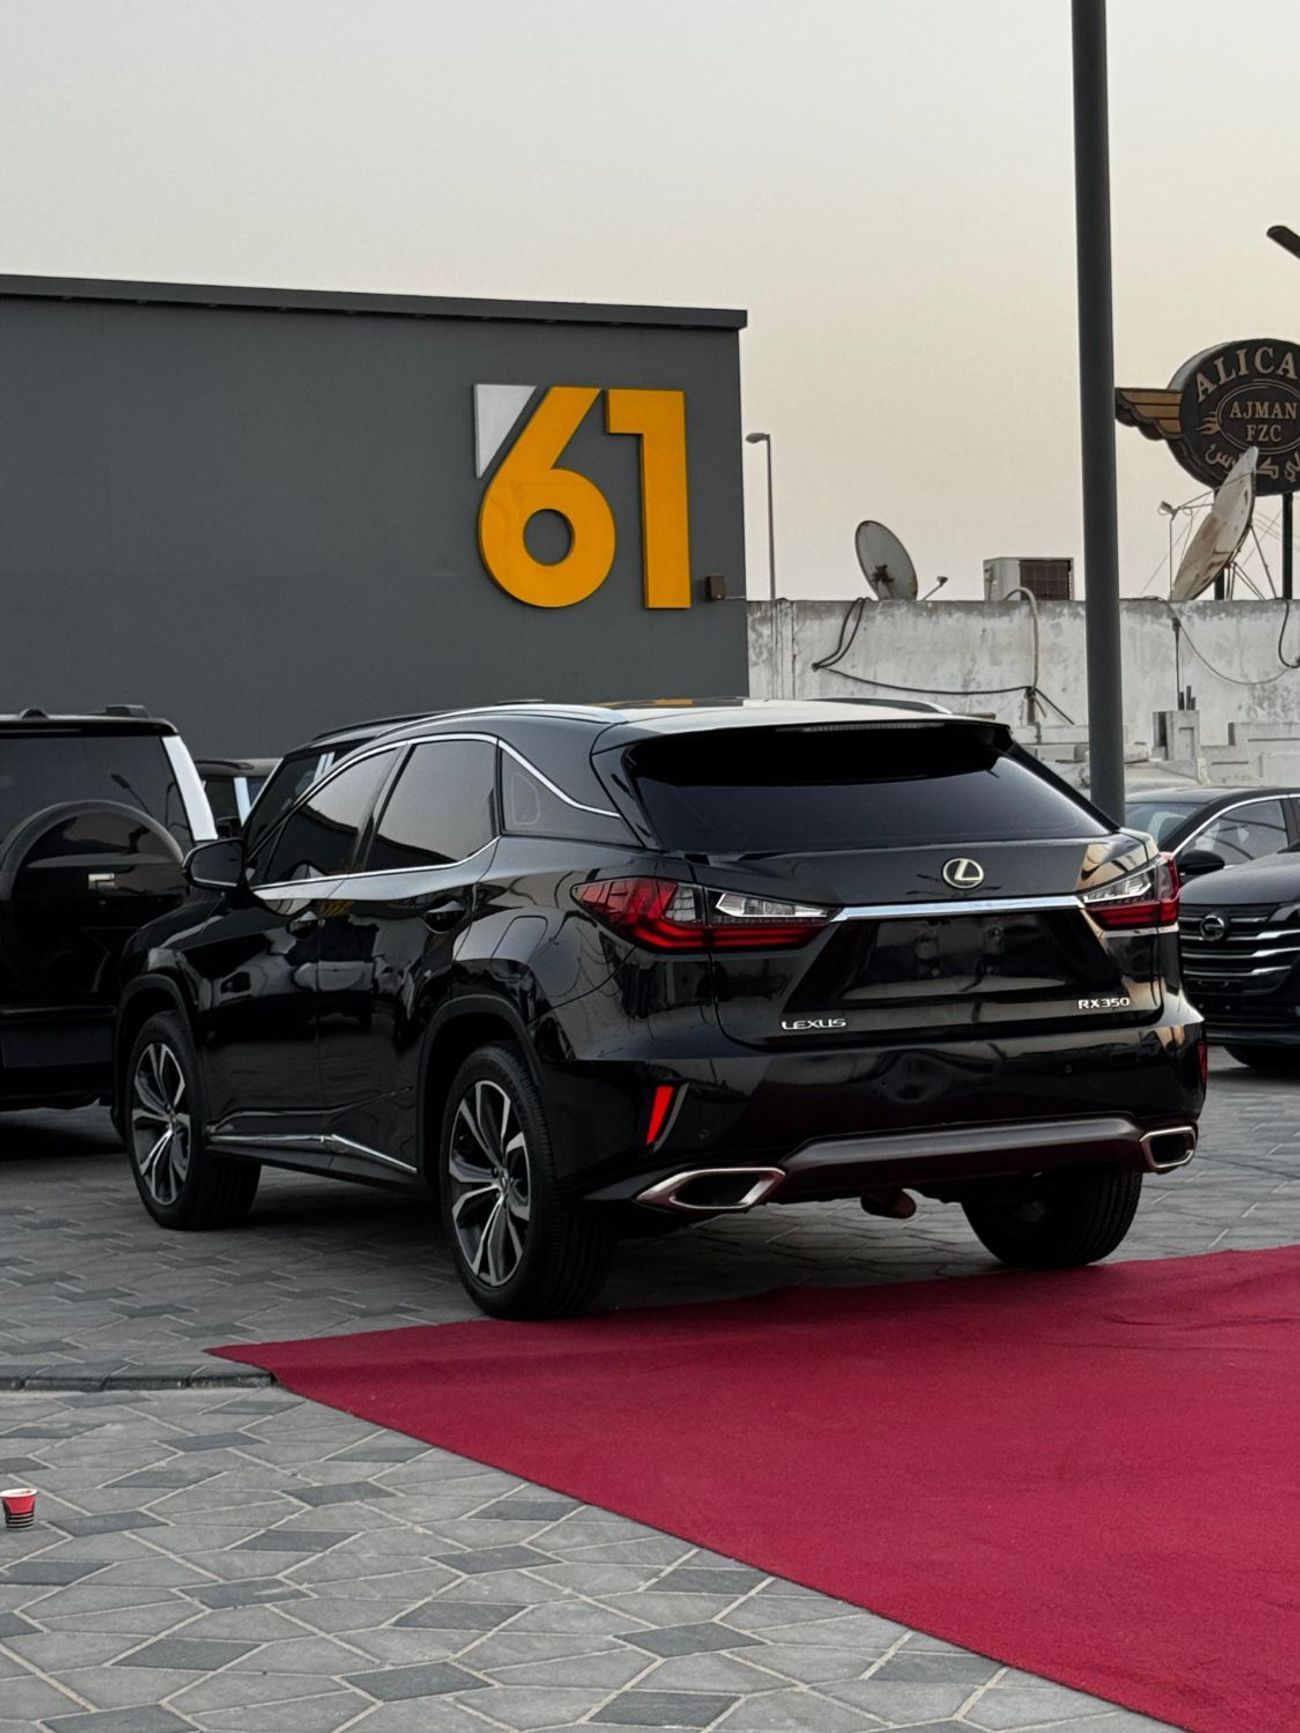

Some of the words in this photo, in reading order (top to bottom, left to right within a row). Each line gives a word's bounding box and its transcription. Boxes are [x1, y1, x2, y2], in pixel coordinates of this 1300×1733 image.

[1230, 402, 1297, 419] AJMAN
[1247, 424, 1281, 441] FZC
[479, 386, 691, 608] 61
[781, 1018, 847, 1030] LEXUS
